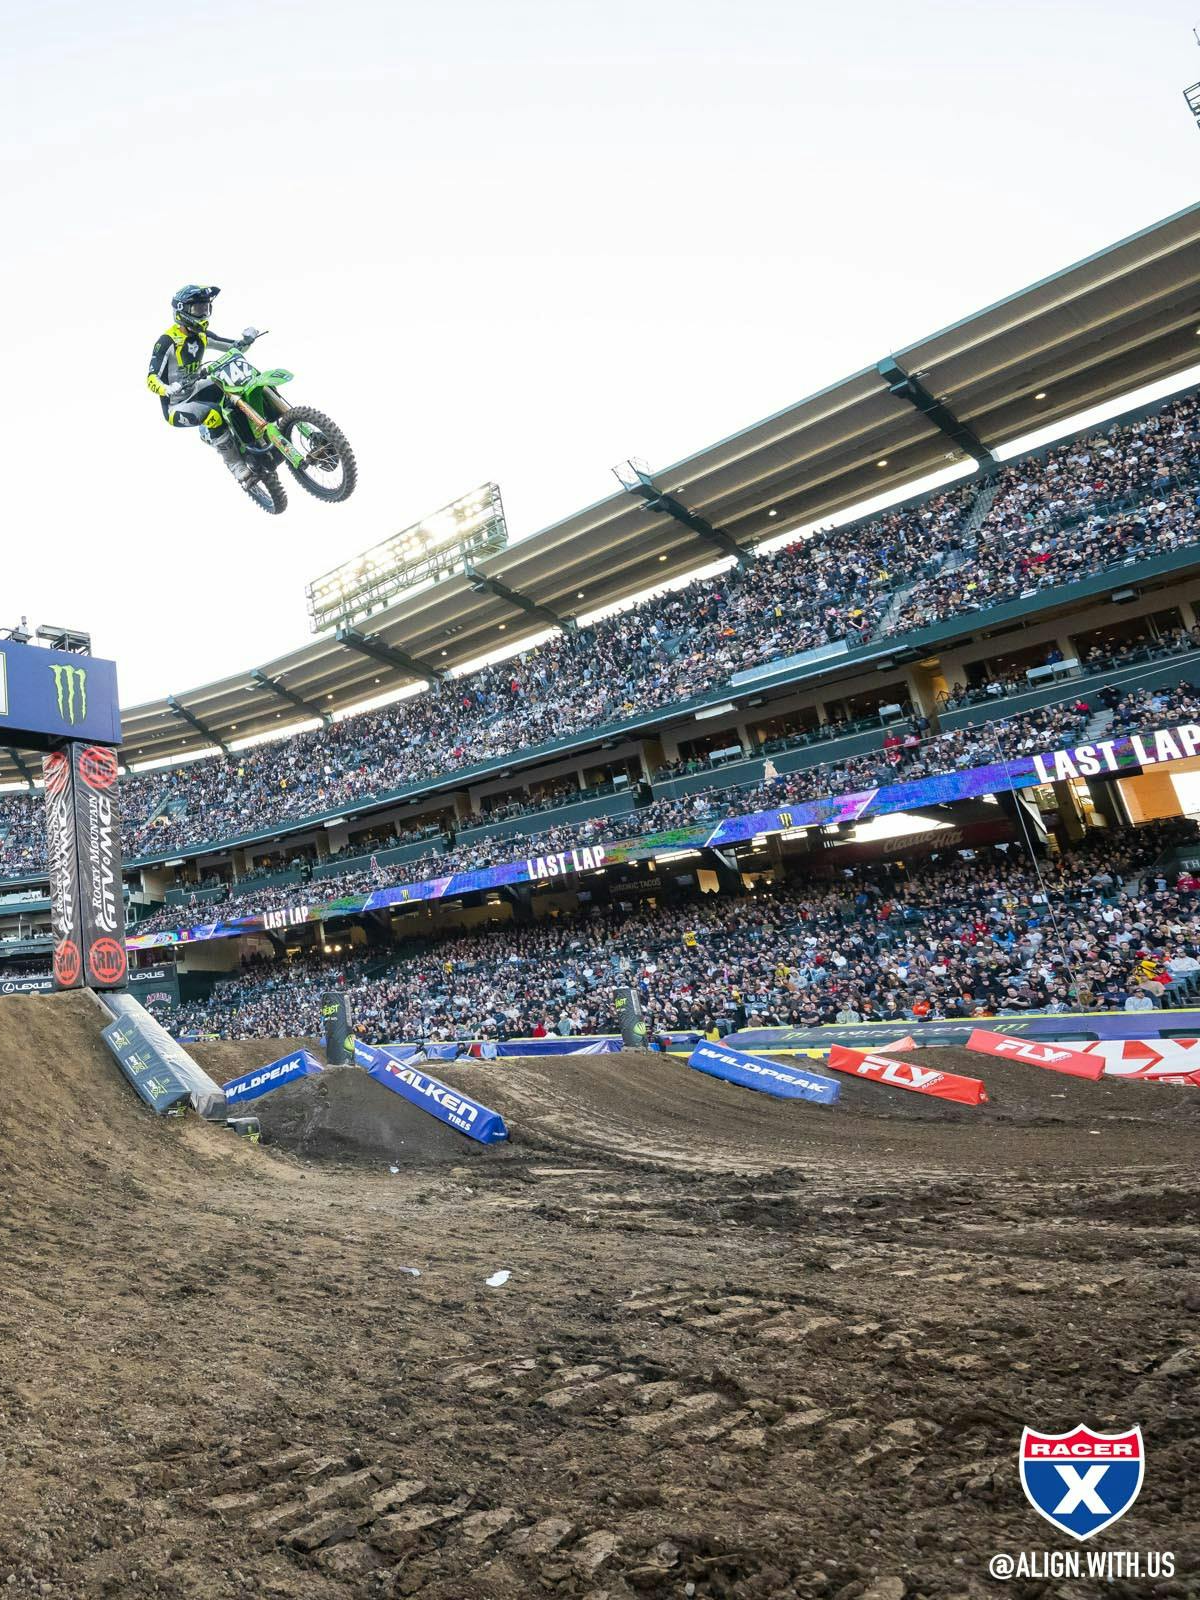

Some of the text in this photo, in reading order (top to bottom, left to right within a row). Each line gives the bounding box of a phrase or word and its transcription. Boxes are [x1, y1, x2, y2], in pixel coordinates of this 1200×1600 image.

[1032, 724, 1200, 784] LAST LAP
[89, 794, 102, 909] ROCKY MOUNTAIN
[527, 846, 605, 880] LAST LAP
[264, 905, 309, 930] LAST LAP
[15, 981, 52, 992] LEXUS
[129, 970, 165, 981] LEXUS
[995, 1039, 1072, 1062] FLY
[225, 1058, 301, 1098] WILDPEAK
[698, 1048, 831, 1093] WILDPEAK
[857, 1055, 943, 1088] FLY
[921, 1075, 944, 1089] RACING
[385, 1060, 479, 1122] FALKEN
[447, 1112, 472, 1131] TIRES
